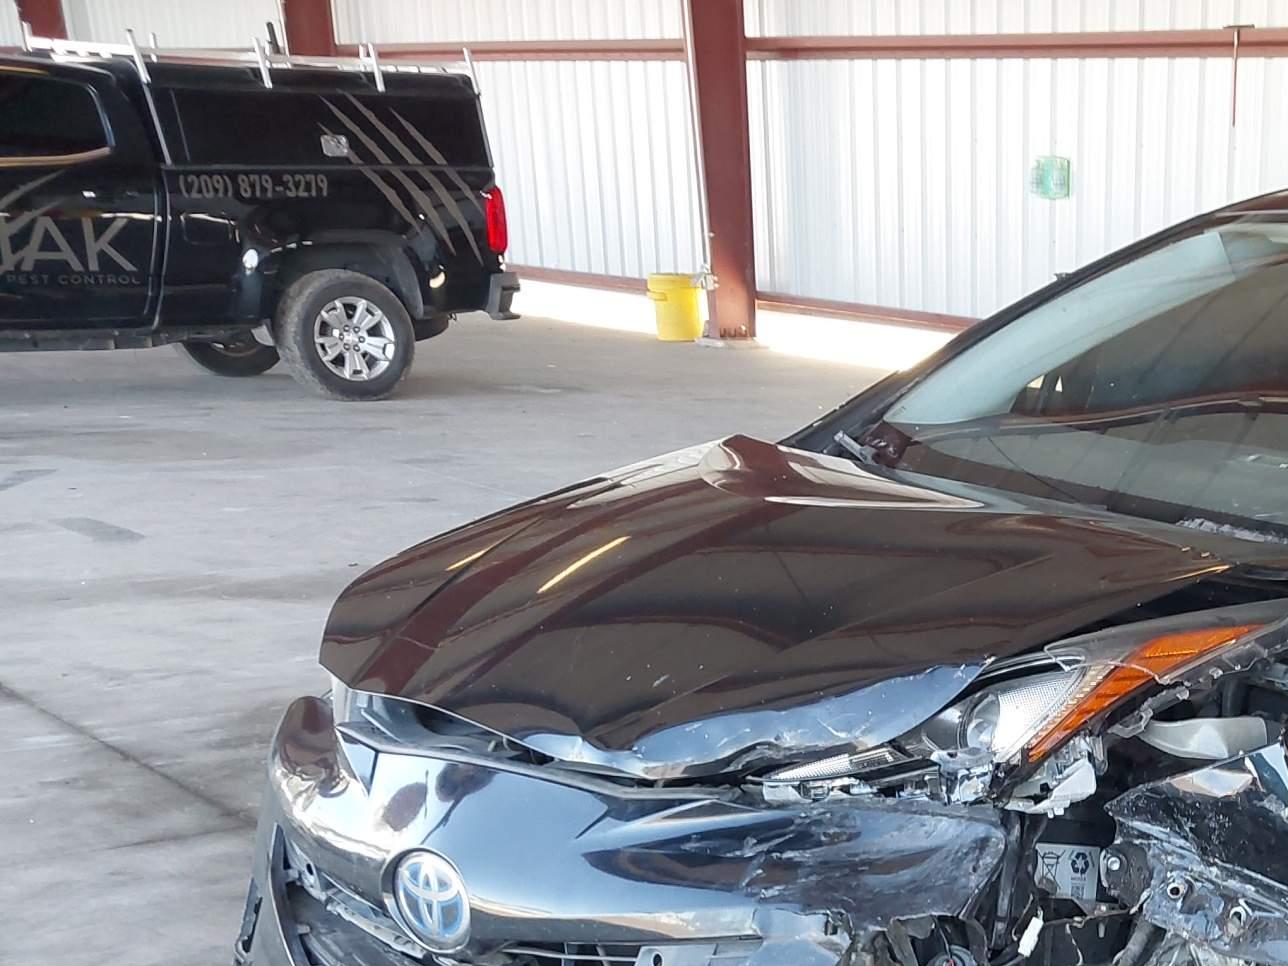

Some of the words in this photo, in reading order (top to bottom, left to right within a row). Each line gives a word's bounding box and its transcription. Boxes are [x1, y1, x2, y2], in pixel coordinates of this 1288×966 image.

[178, 174, 233, 198] (209)
[238, 174, 328, 198] 879-3279
[6, 274, 49, 285] PEST
[58, 274, 141, 285] CONTROL
